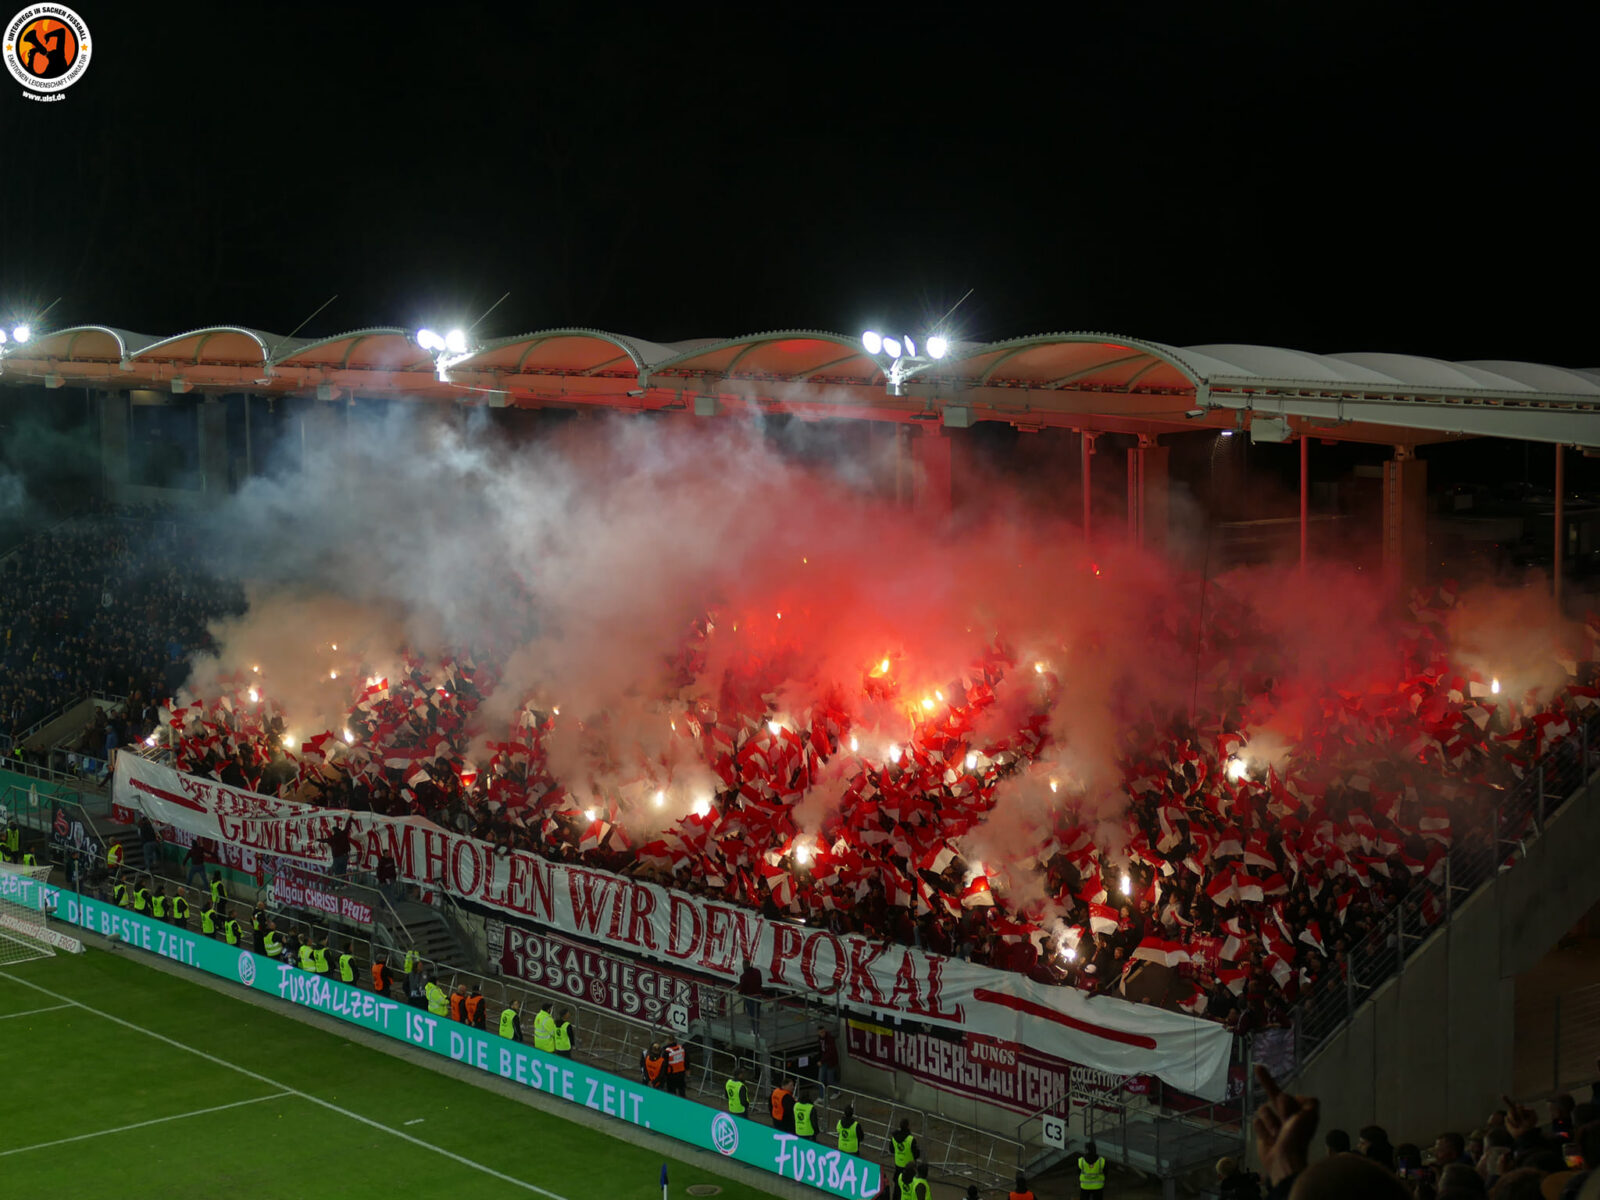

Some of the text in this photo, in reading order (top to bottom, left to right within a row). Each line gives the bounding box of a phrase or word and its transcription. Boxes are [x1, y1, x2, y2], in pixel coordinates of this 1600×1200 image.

[67, 899, 95, 930] DIE
[101, 914, 152, 951] BESTE
[157, 930, 201, 968] ZEIT.
[274, 878, 304, 905] Allgäu
[304, 888, 339, 914] CHRISSI
[341, 897, 373, 923] Pfalz
[421, 829, 556, 923] HOLEN
[564, 867, 660, 951] WIR
[664, 889, 765, 976] DEN
[768, 921, 966, 1025] POKAL
[510, 928, 692, 1008] POKALSIEGER
[514, 951, 585, 996] 1990
[608, 982, 673, 1022] 199
[672, 1010, 687, 1026] C2
[406, 1011, 438, 1047] IST
[449, 1031, 489, 1069] DIE
[499, 1048, 574, 1101] BESTE
[584, 1077, 652, 1129] ZEIT.
[970, 1041, 1016, 1067] JUNGS
[772, 1133, 881, 1198] FUSSBAL
[1045, 1122, 1064, 1142] C3
